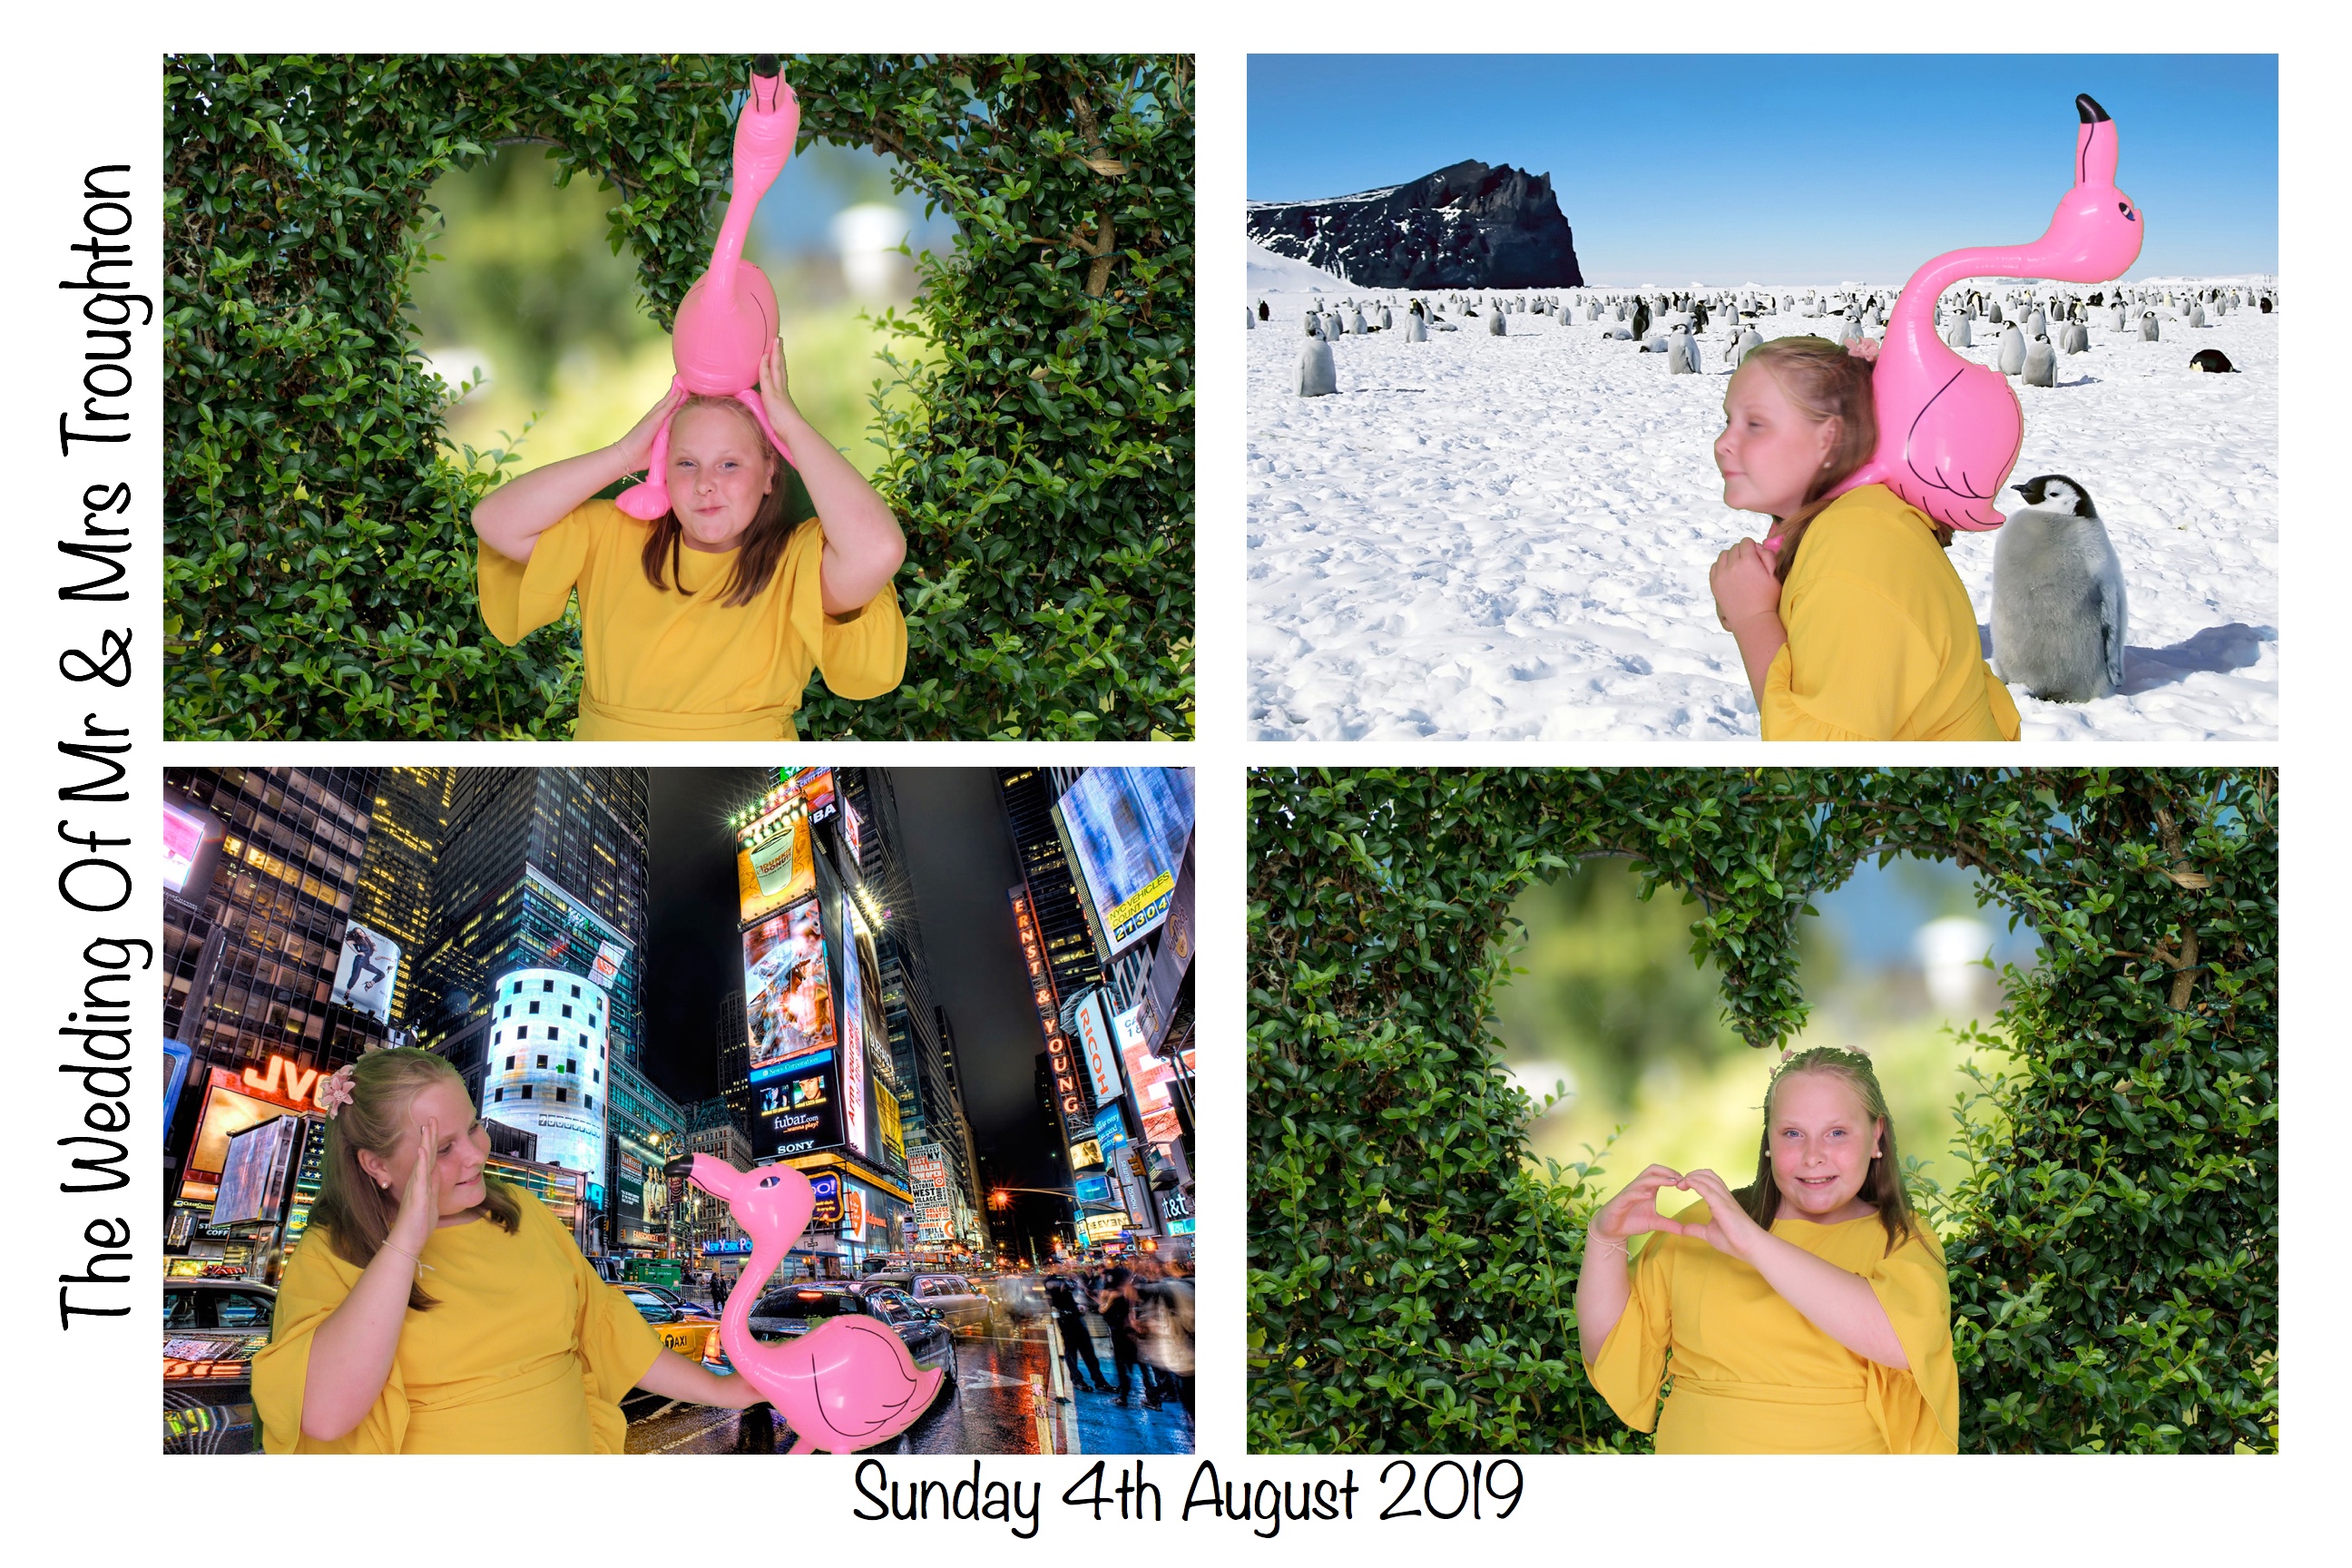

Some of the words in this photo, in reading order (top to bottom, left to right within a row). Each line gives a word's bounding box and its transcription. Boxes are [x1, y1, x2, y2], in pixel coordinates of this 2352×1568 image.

[1110, 903, 1127, 920] NYC
[1126, 871, 1170, 906] VEHICLES
[1112, 902, 1141, 927] COUNT
[1116, 891, 1174, 941] 21304
[1014, 898, 1041, 975] ERNST
[1037, 989, 1051, 1004] &
[1044, 1019, 1080, 1113] YOUNG
[1080, 1007, 1109, 1095] RICOH
[769, 1067, 783, 1075] News
[784, 1057, 818, 1071] Corporation
[774, 1113, 818, 1129] fubar.com
[778, 1140, 815, 1154] SONY
[910, 1157, 926, 1166] EAST
[927, 1152, 940, 1161] NY
[910, 1162, 941, 1173] HARLEM
[926, 1170, 942, 1179] OPEN
[912, 1182, 935, 1191] ASTORIA
[913, 1188, 936, 1198] WEST
[702, 1240, 720, 1252] NEW
[720, 1240, 739, 1251] YORK
[665, 1334, 687, 1348] TAXI
